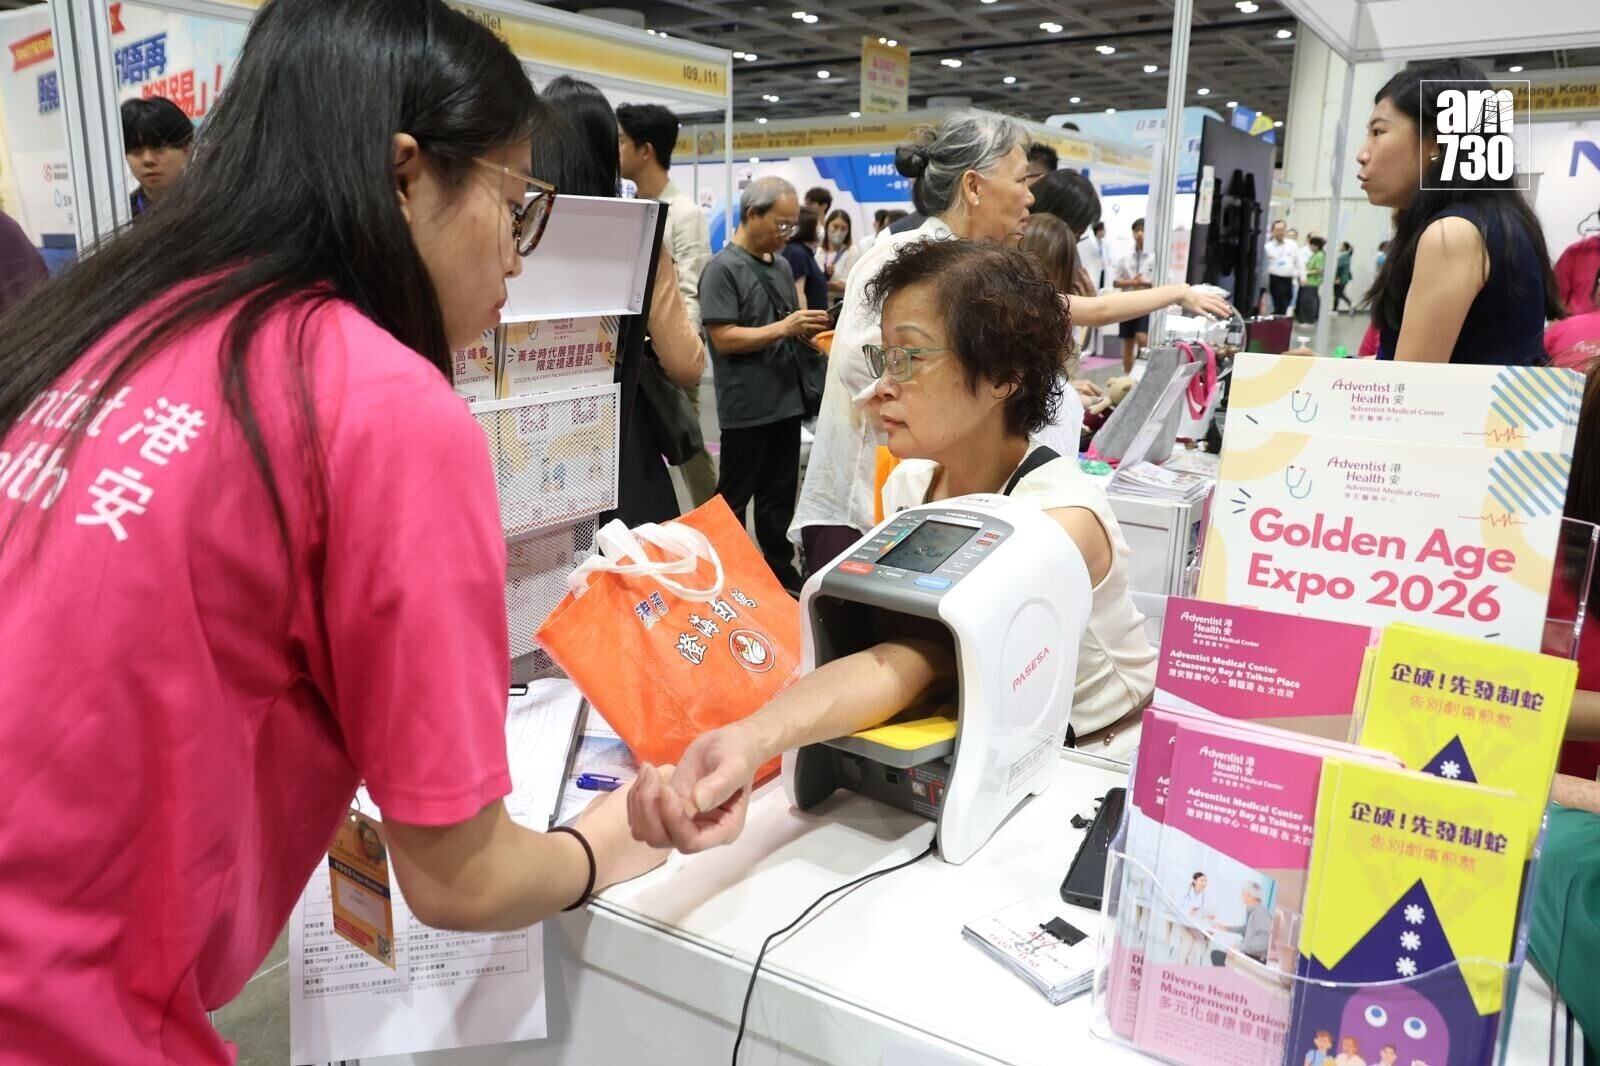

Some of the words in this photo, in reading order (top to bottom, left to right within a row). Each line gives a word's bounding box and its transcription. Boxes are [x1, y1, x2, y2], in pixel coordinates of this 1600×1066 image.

[1517, 87, 1554, 97] Hong
[1560, 83, 1597, 94] Kong
[868, 164, 899, 176] HMS
[517, 341, 613, 363] 黃金時代展覽暨高峰會
[535, 354, 593, 371] 限定禮遇登記
[1332, 378, 1391, 393] Adventist
[1351, 394, 1390, 405] Health
[1351, 405, 1385, 413] Adventist
[1387, 407, 1417, 415] Medical
[1418, 409, 1445, 417] Center
[117, 396, 207, 466] 港
[1327, 456, 1387, 472] Adventist
[1346, 471, 1385, 484] Health
[1345, 483, 1380, 492] Adventist
[1382, 487, 1412, 496] Medical
[1414, 490, 1440, 499] Center
[75, 466, 154, 542] 安
[1250, 507, 1406, 560] Golden
[1414, 528, 1516, 580] Age
[1248, 552, 1355, 604] Expo
[1366, 570, 1501, 622] 2026
[1180, 611, 1222, 626] Adventist
[1193, 623, 1221, 635] Health
[1193, 632, 1218, 641] Adventist
[1219, 636, 1240, 645] Medical
[1012, 646, 1050, 693] PASESA
[1169, 649, 1210, 663] Adventist
[1212, 656, 1246, 669] Medical
[1247, 662, 1278, 674] Center
[1175, 660, 1217, 674] Causeway
[1218, 667, 1235, 677] Bay
[1236, 670, 1244, 678] &
[1245, 671, 1274, 683] Taikoo
[1276, 677, 1301, 689] Place
[1199, 745, 1244, 765] Adventist
[1213, 760, 1243, 775] Health
[1263, 781, 1284, 791] Center
[1187, 787, 1231, 804] Adventist
[1233, 798, 1270, 814] Medical
[1271, 806, 1304, 821] Center
[1193, 799, 1237, 817] Causeway
[1239, 809, 1257, 822] Bay
[1258, 814, 1266, 823] &
[1268, 816, 1300, 831] Taikoo
[1161, 970, 1205, 991] Diverse
[1207, 984, 1248, 1006] Health
[1160, 981, 1239, 1016] Management
